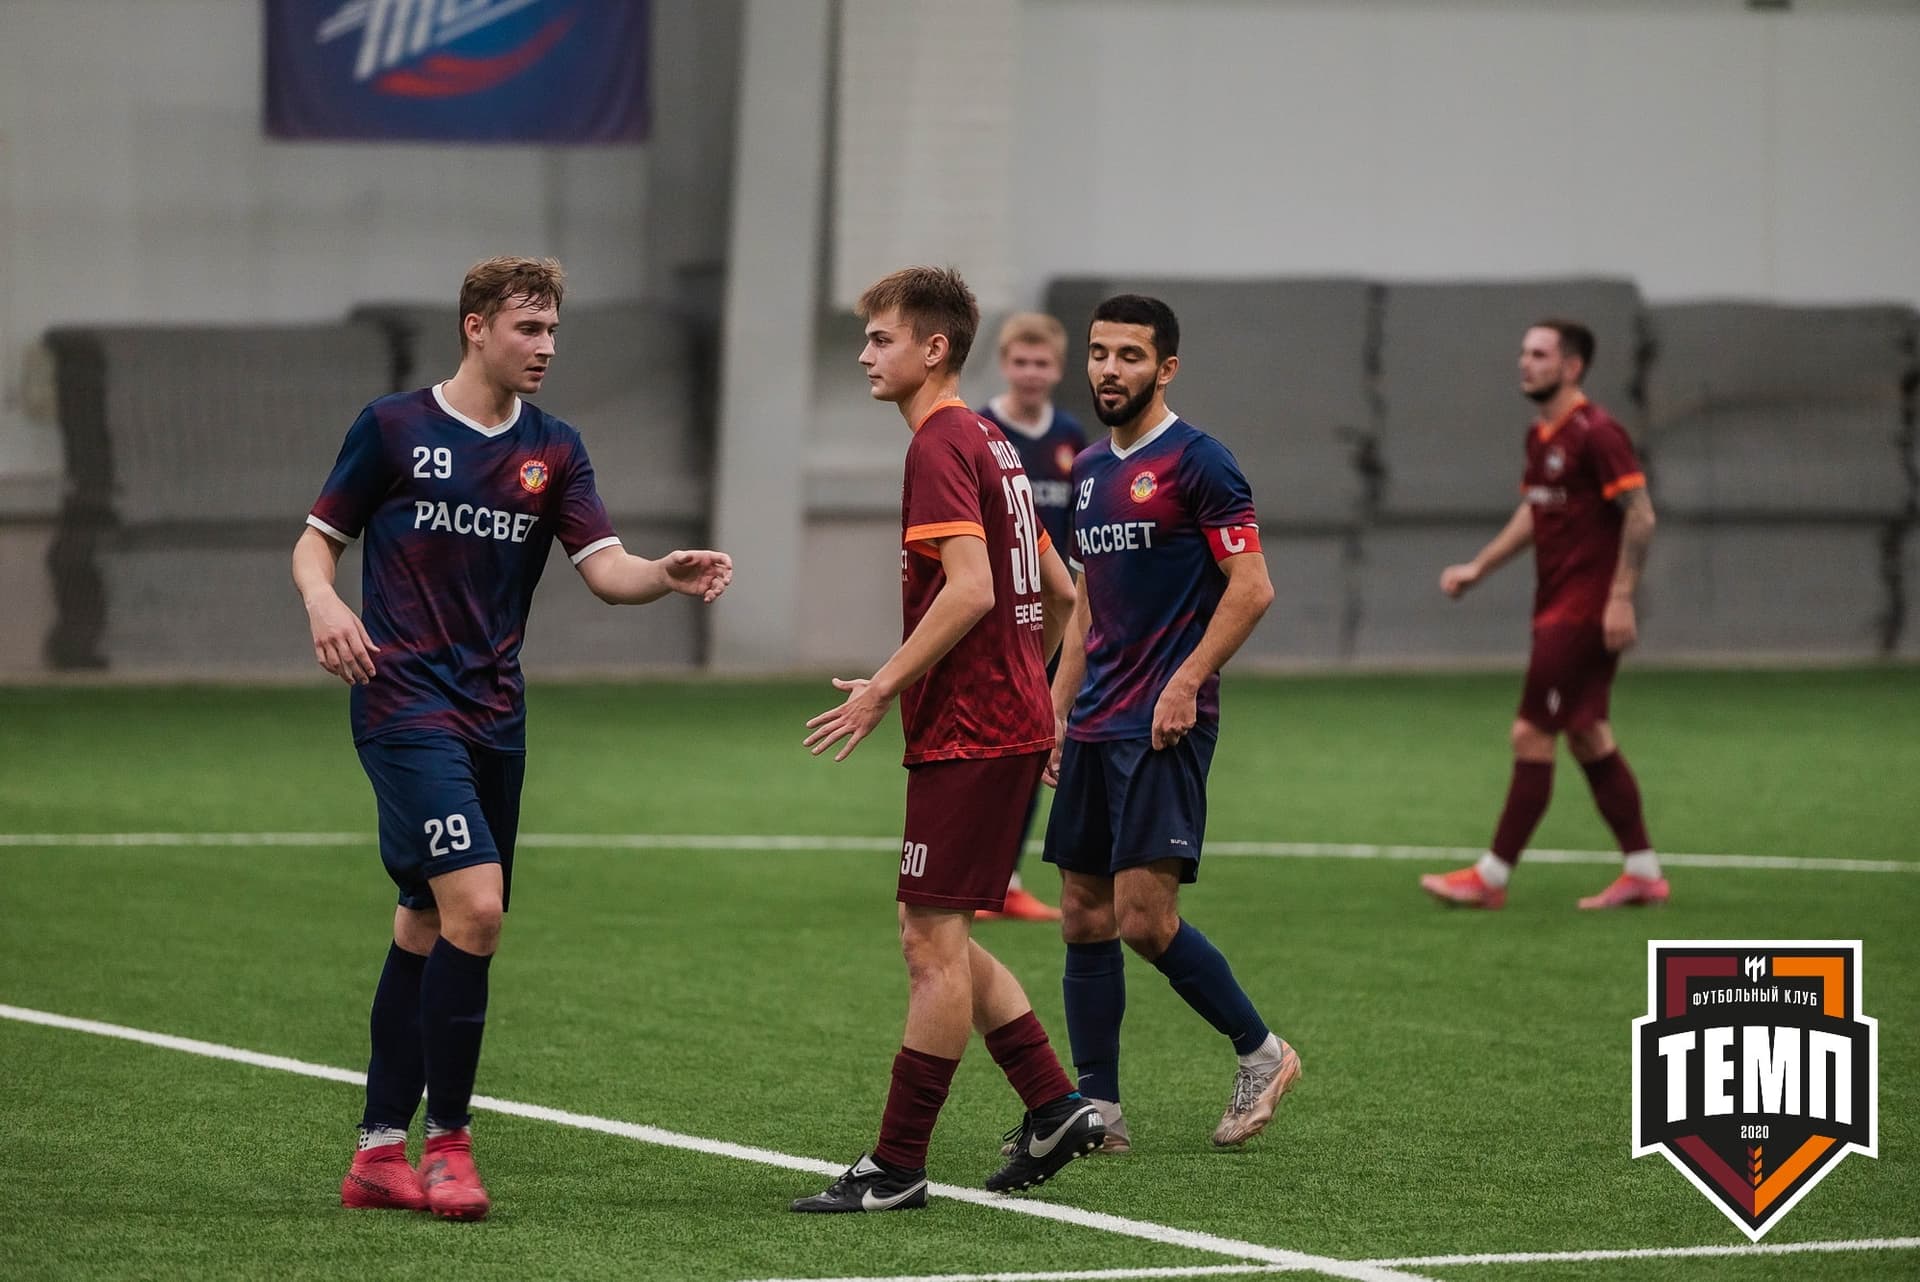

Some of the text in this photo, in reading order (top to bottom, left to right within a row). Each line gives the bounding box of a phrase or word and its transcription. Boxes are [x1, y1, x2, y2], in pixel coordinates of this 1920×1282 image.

[413, 446, 452, 479] 29
[414, 501, 540, 543] РАССВЕТ
[1002, 474, 1041, 595] 30
[424, 813, 472, 857] 29
[901, 841, 928, 877] 30
